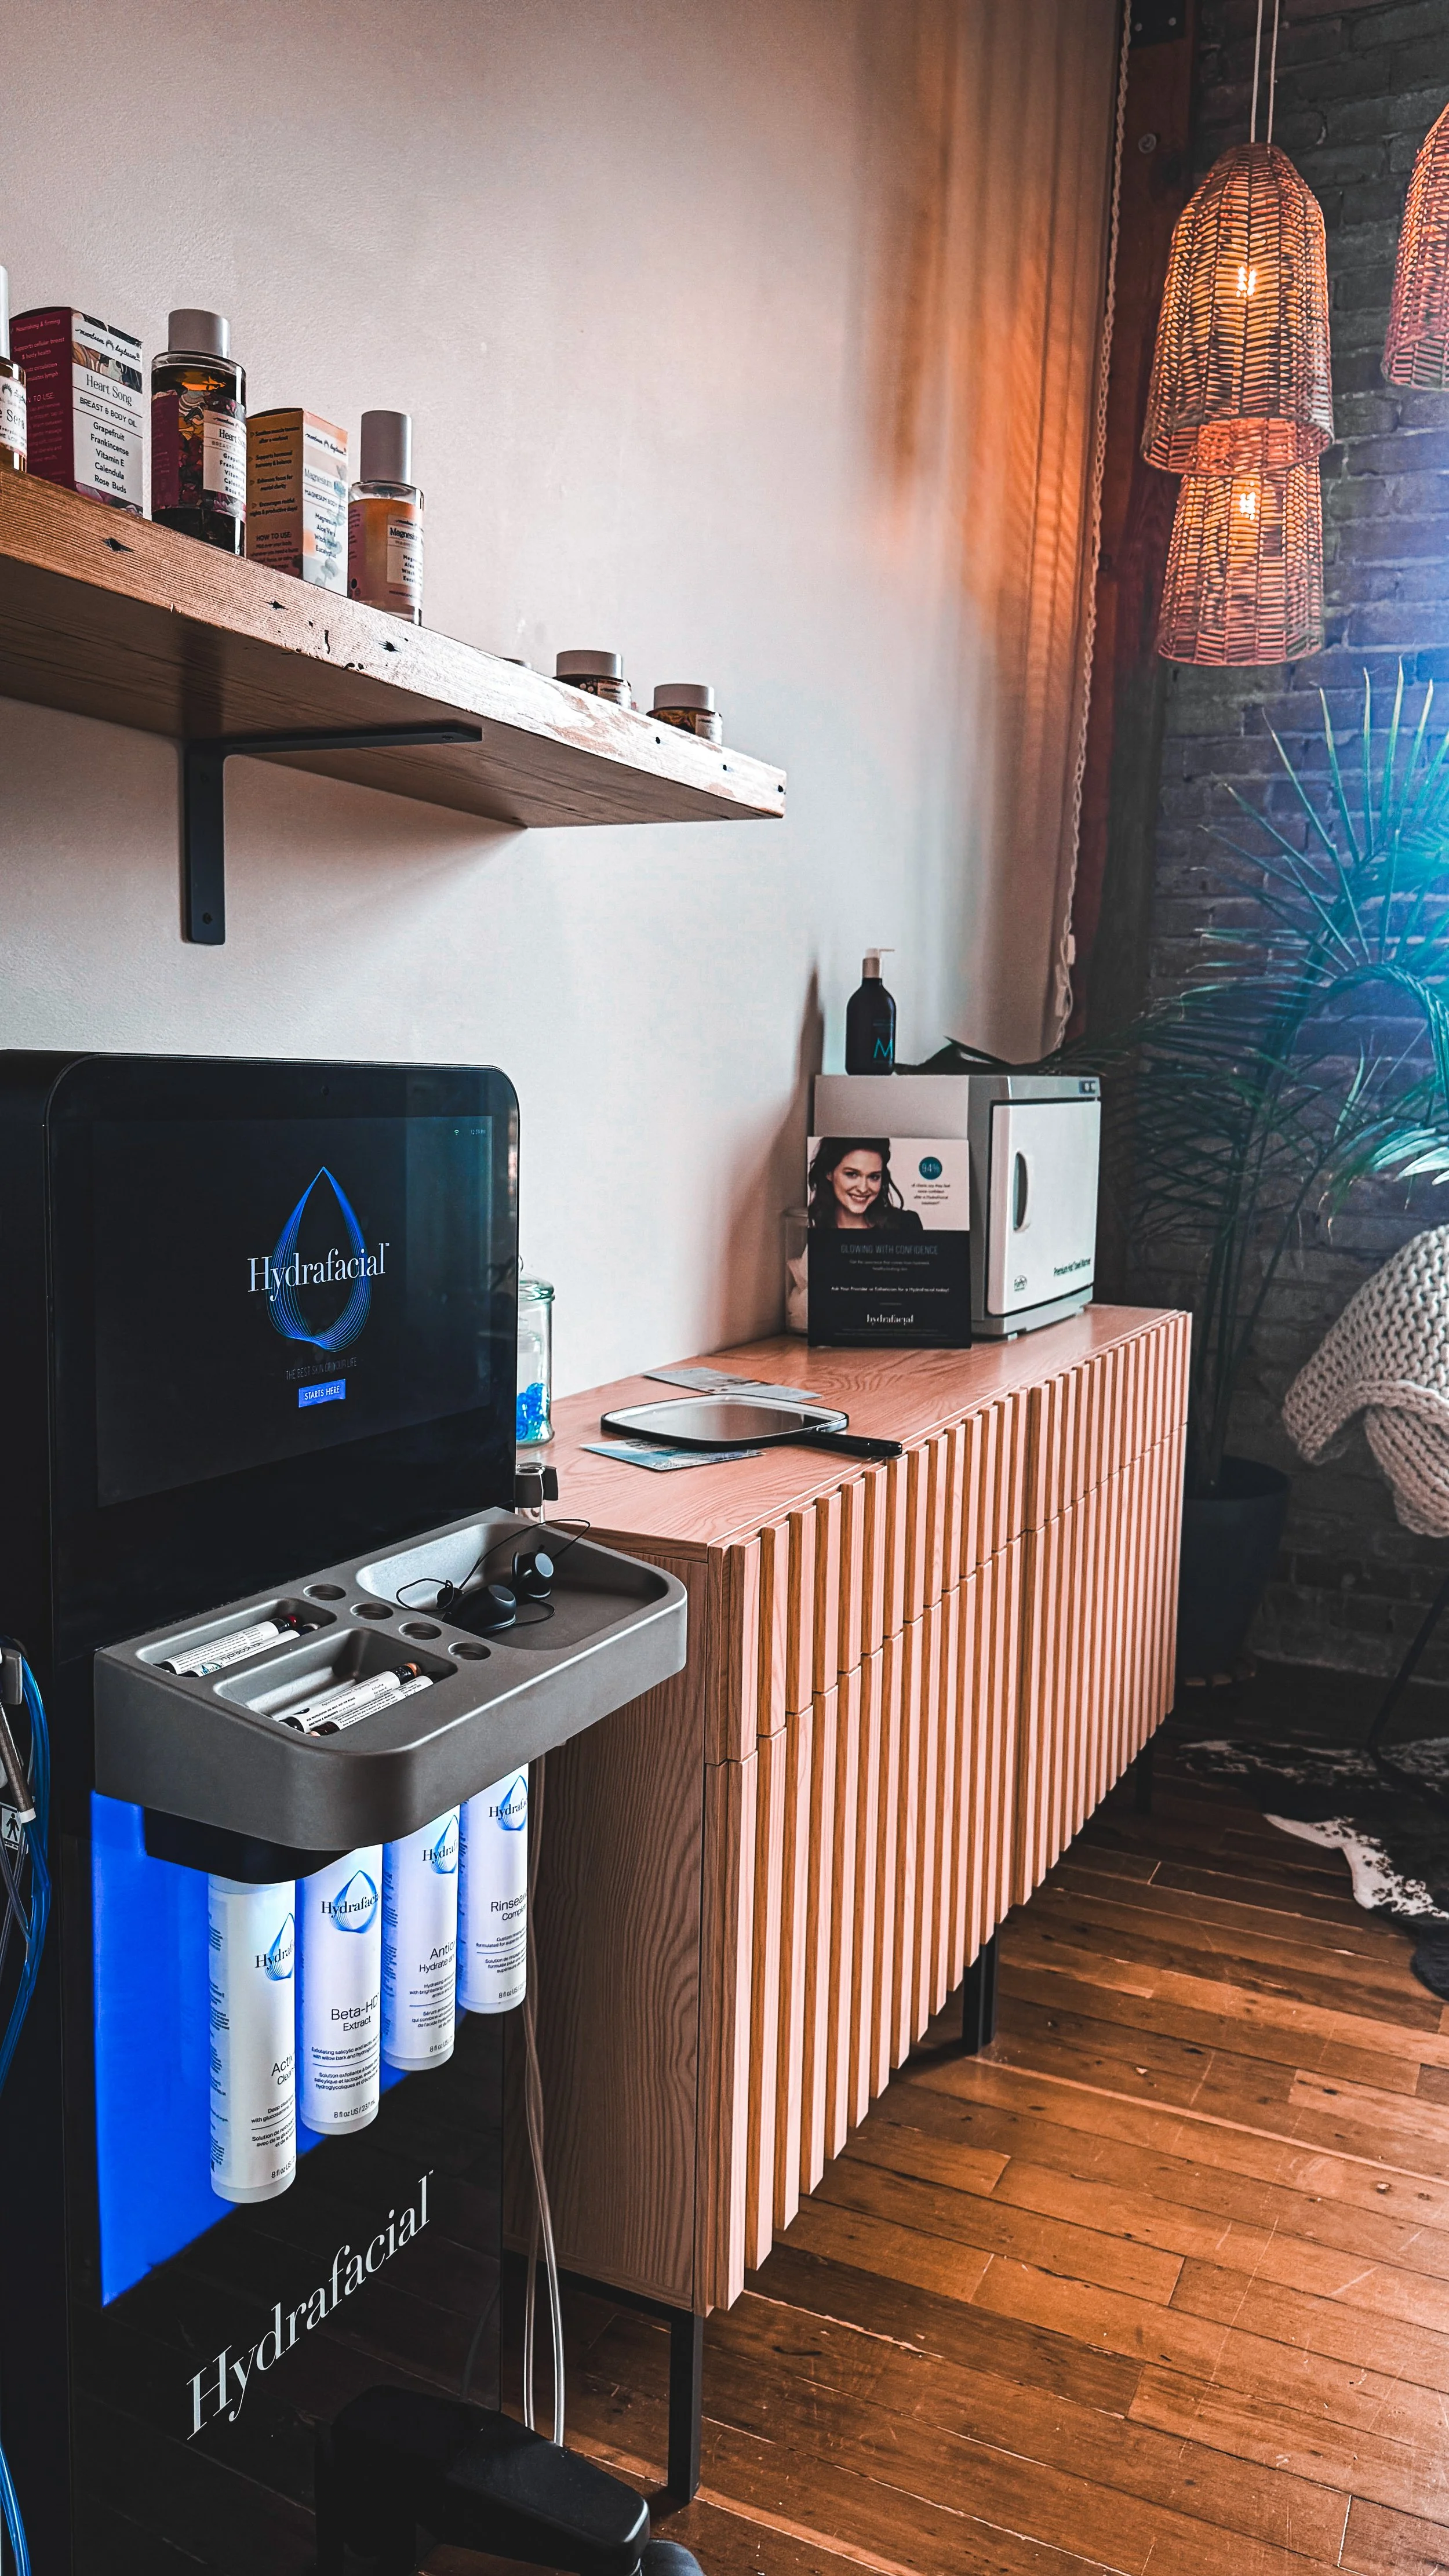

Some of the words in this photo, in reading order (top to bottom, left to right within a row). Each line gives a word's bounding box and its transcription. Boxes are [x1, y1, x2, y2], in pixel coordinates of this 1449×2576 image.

[87, 374, 110, 394] Heart
[112, 386, 132, 406] Song
[80, 397, 103, 412] BREAST
[111, 410, 126, 422] BODY
[128, 419, 137, 427] OIL
[94, 422, 125, 441] Grapefruit
[219, 429, 236, 443] Heart
[91, 434, 129, 456] Frankincense
[96, 449, 119, 465] Vitamin
[95, 462, 124, 479] Calendula
[95, 475, 109, 487] Rose
[112, 482, 126, 493] Buds
[873, 1038, 893, 1058] M
[840, 1245, 873, 1254] GLOWING
[875, 1245, 894, 1254] WITH
[895, 1245, 938, 1256] CONFIDENCE
[867, 1314, 913, 1325] hydrafacial
[286, 1369, 296, 1380] THE
[297, 1366, 310, 1378] BEST
[312, 1363, 323, 1374] SKIN
[325, 1362, 331, 1372] OF
[333, 1359, 346, 1371] YOUR
[348, 1357, 356, 1367] LIFE
[305, 1389, 324, 1400] STARTS
[326, 1386, 340, 1395] HERE
[420, 1959, 447, 1973] Hydrate
[343, 2016, 371, 2031] Extract
[340, 2069, 361, 2077] exfoliante
[268, 2105, 280, 2113] Deep
[362, 2102, 370, 2112] 237
[252, 2133, 273, 2142] Solution
